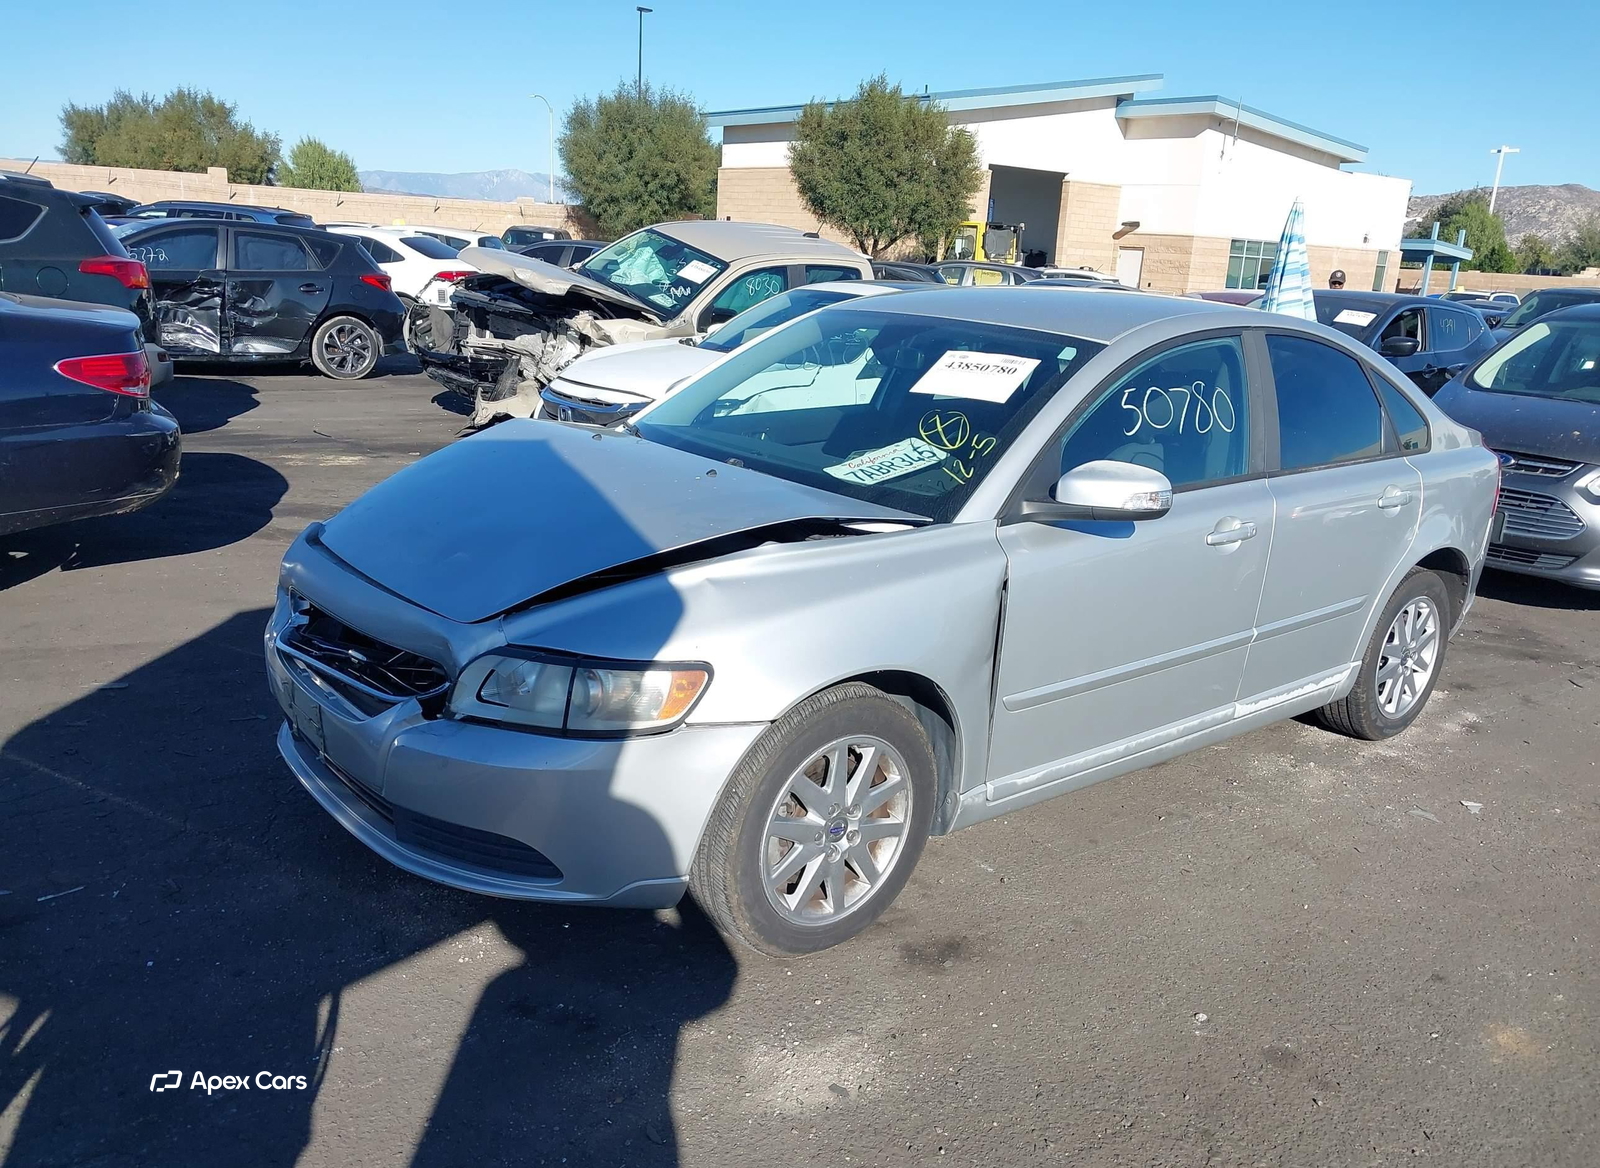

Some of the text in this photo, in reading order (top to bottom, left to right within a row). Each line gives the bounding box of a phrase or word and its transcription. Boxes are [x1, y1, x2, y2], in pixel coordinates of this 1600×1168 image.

[745, 277, 780, 297] 8030
[945, 361, 1018, 375] 43850780
[1121, 380, 1236, 436] 50780
[843, 445, 938, 482] 7ABR345
[848, 447, 904, 469] California
